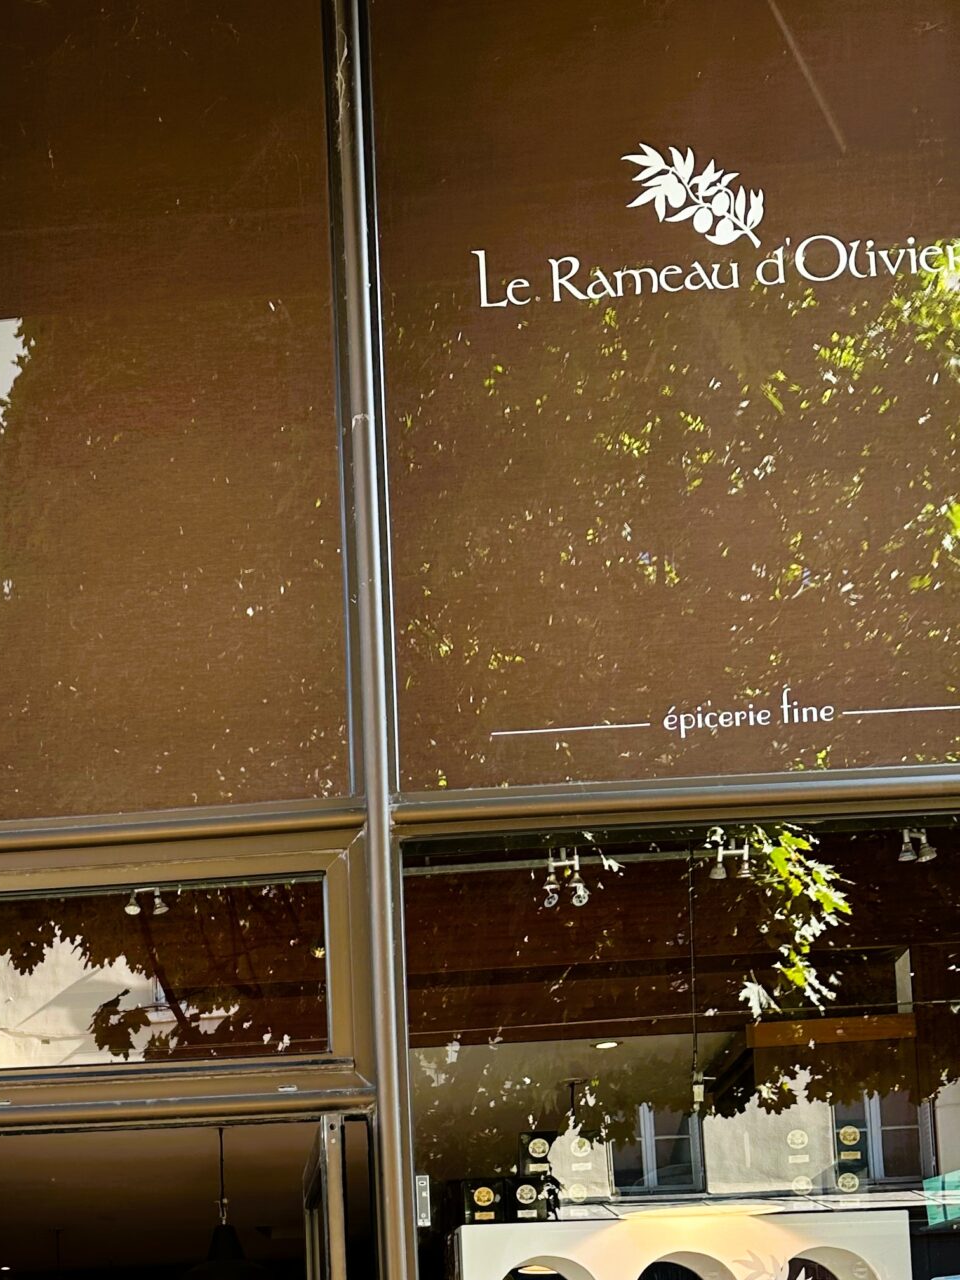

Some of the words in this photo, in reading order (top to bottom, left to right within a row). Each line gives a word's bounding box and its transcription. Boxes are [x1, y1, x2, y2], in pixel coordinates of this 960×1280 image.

[471, 249, 531, 308] Le
[548, 255, 740, 303] Rameau
[663, 697, 772, 738] épicerie
[780, 682, 836, 724] fine
